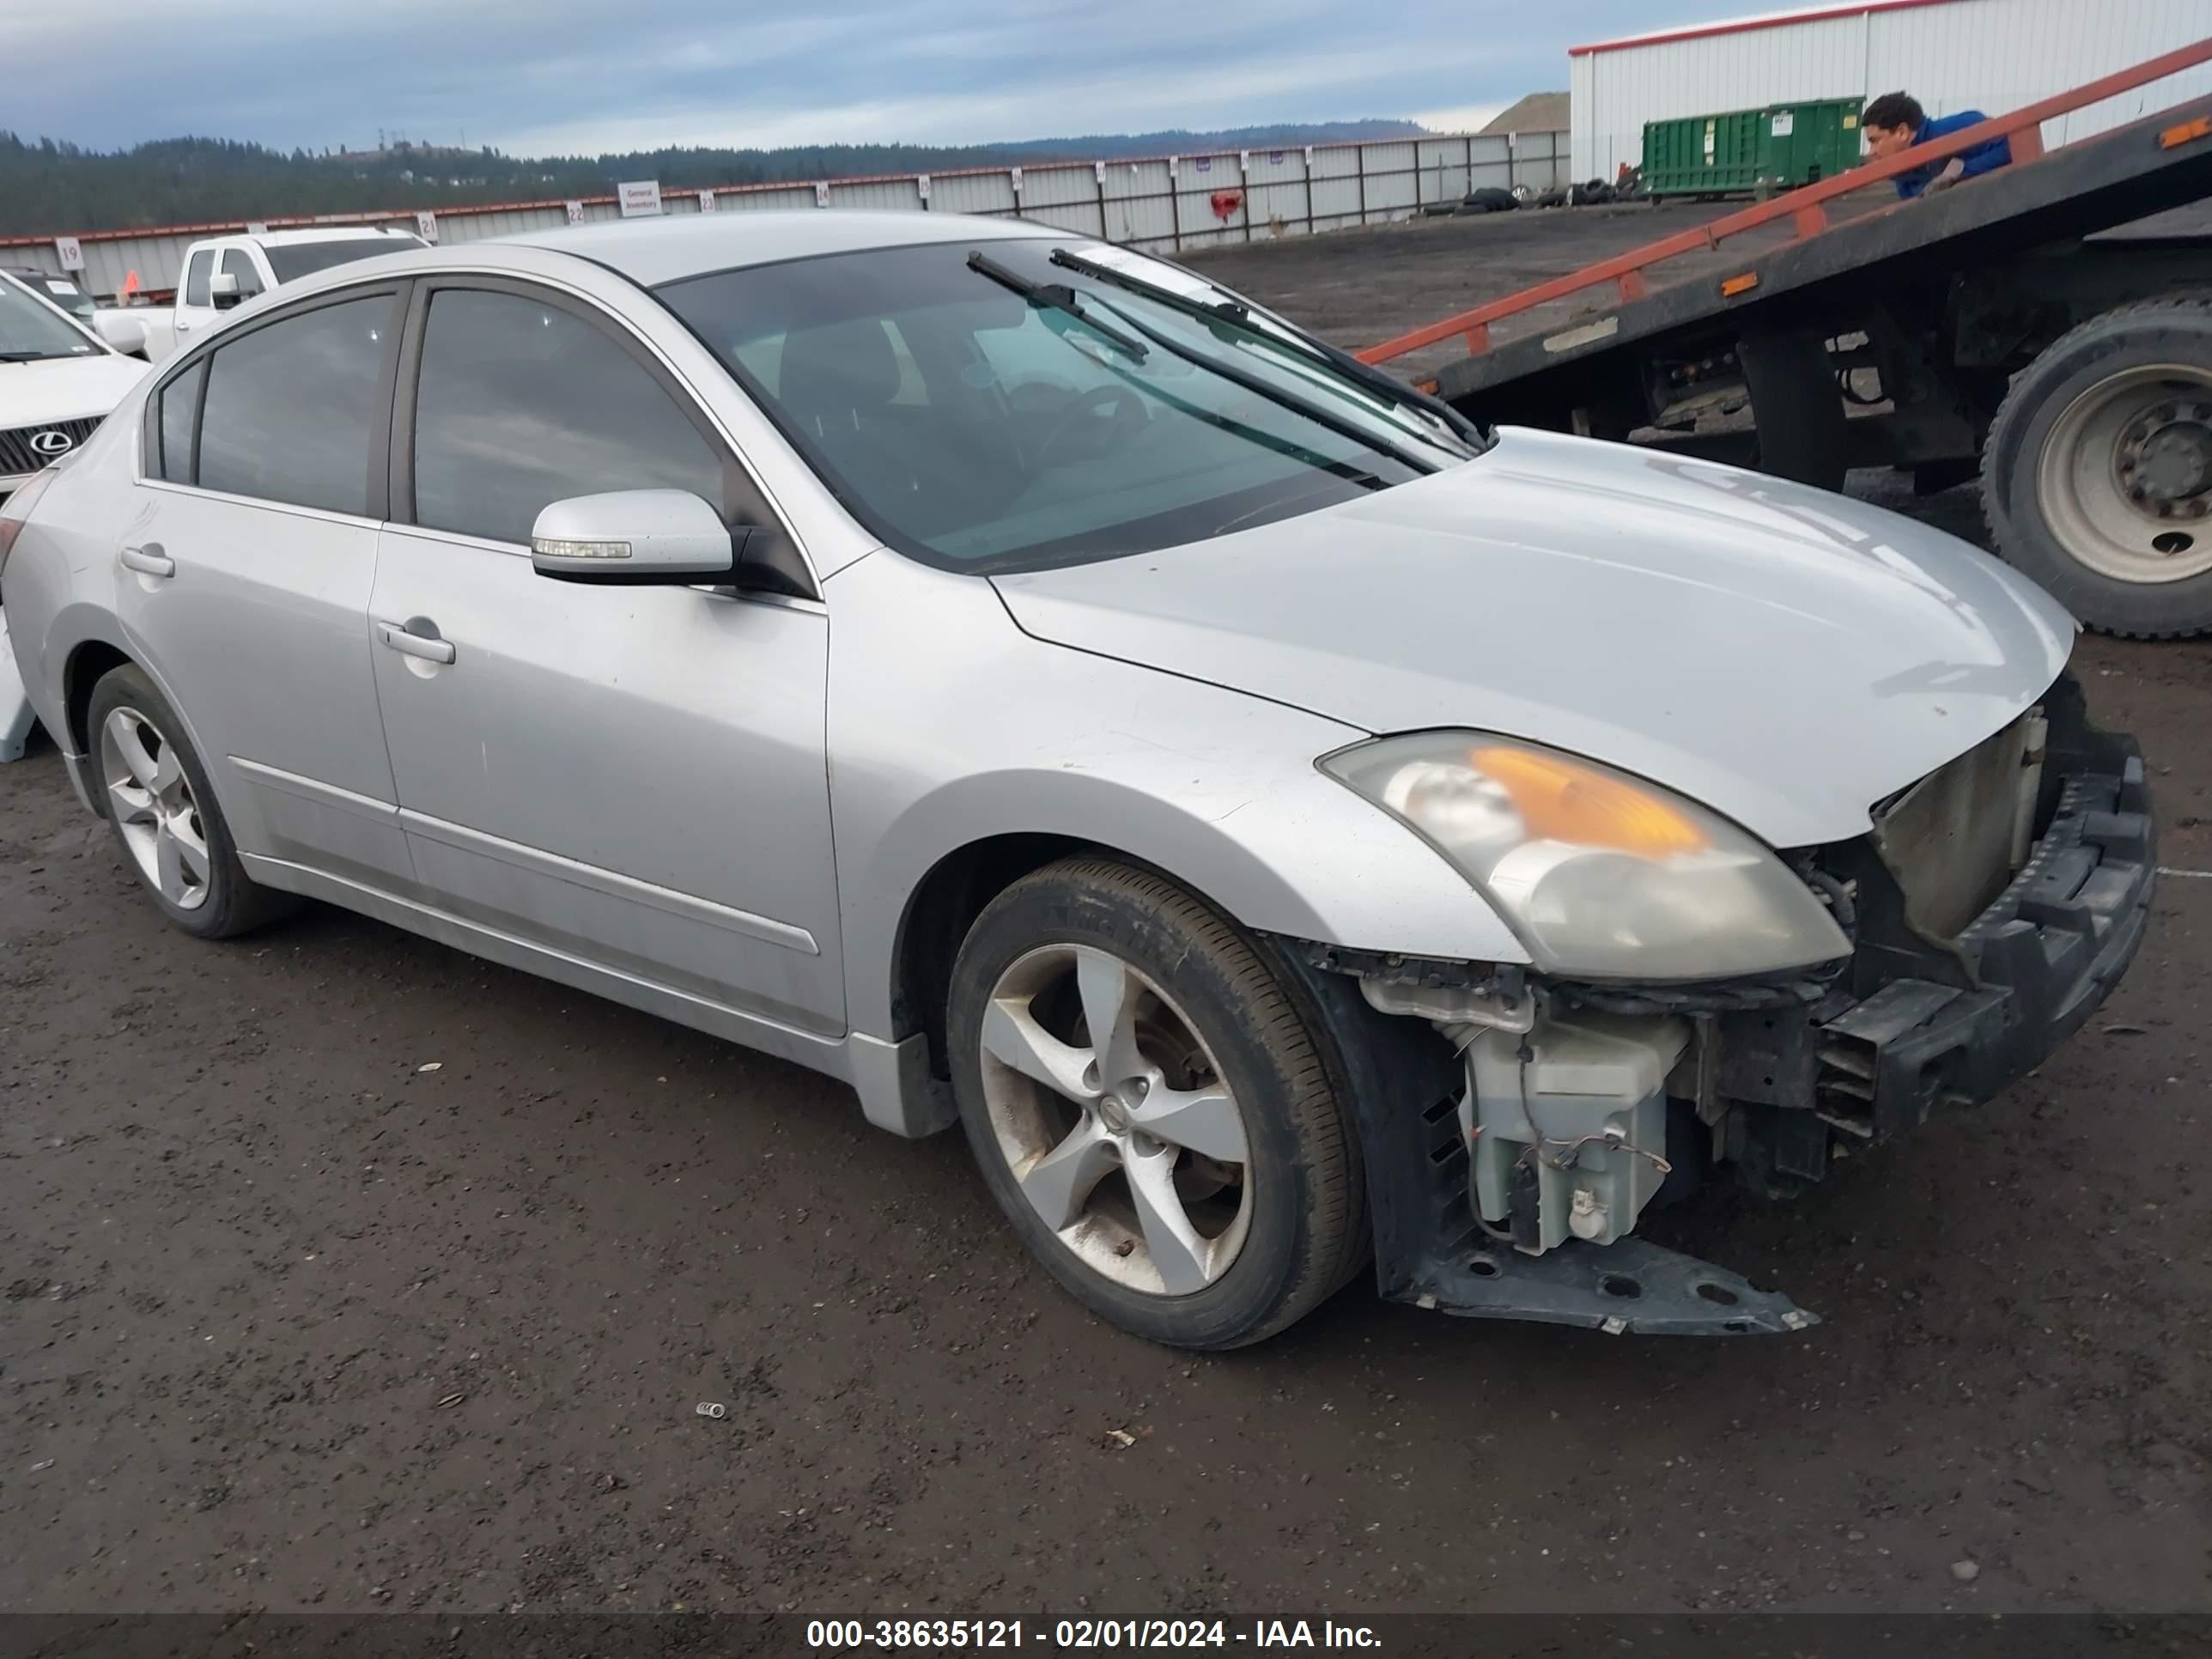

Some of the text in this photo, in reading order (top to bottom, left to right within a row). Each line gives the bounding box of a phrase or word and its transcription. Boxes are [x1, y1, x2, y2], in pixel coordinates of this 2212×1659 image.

[702, 198, 714, 210] 23
[569, 208, 584, 221] 22
[422, 219, 435, 234] 21
[63, 246, 77, 262] 19
